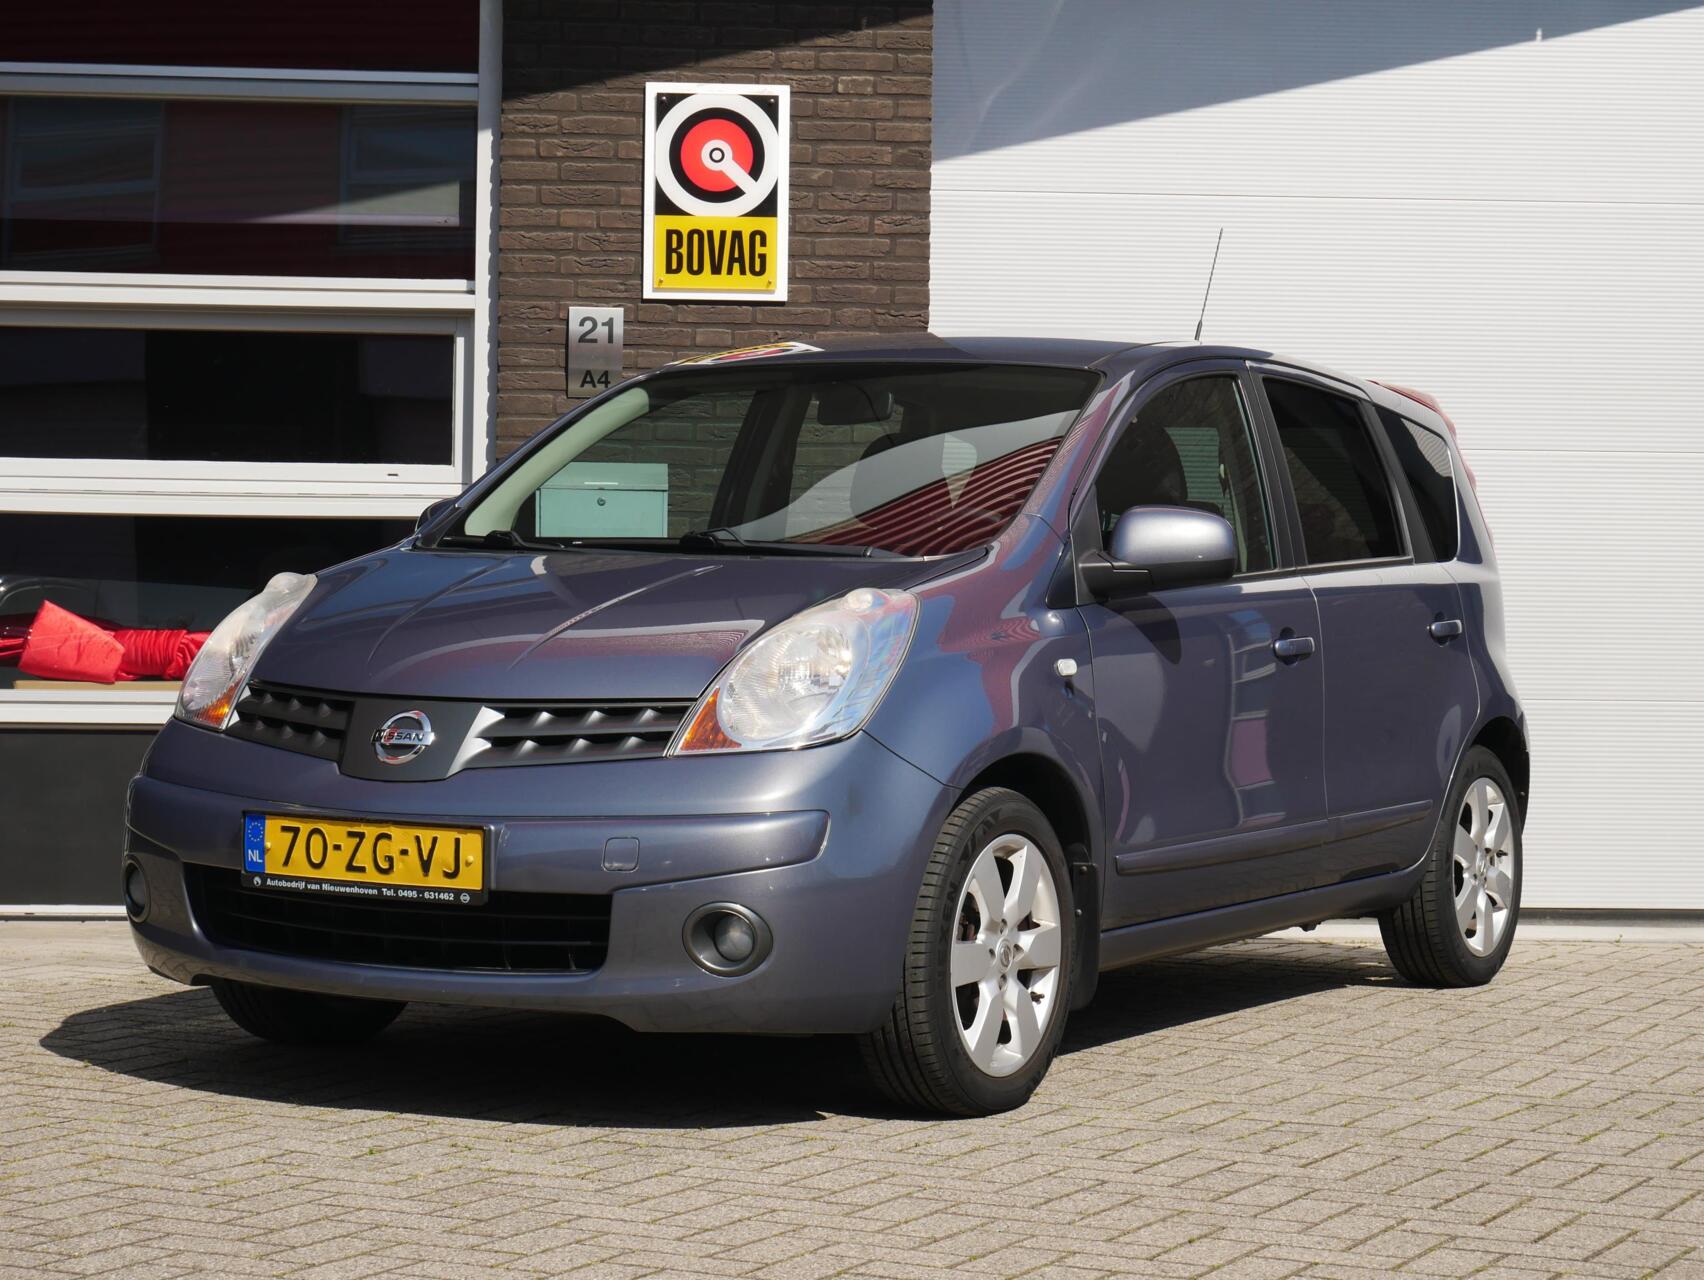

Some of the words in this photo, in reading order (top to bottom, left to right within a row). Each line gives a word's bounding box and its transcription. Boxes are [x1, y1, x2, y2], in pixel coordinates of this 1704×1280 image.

[664, 228, 768, 277] BOVAG
[577, 316, 615, 344] 21
[579, 369, 611, 389] A4
[248, 848, 263, 864] NL
[280, 825, 462, 879] 70-ZG-VJ
[266, 878, 305, 890] Autobedrijf
[307, 882, 320, 890] van
[322, 883, 378, 895] Nieuwenhoven
[381, 888, 396, 897] Tel.
[398, 889, 418, 898] 0495
[424, 891, 454, 901] 631462
